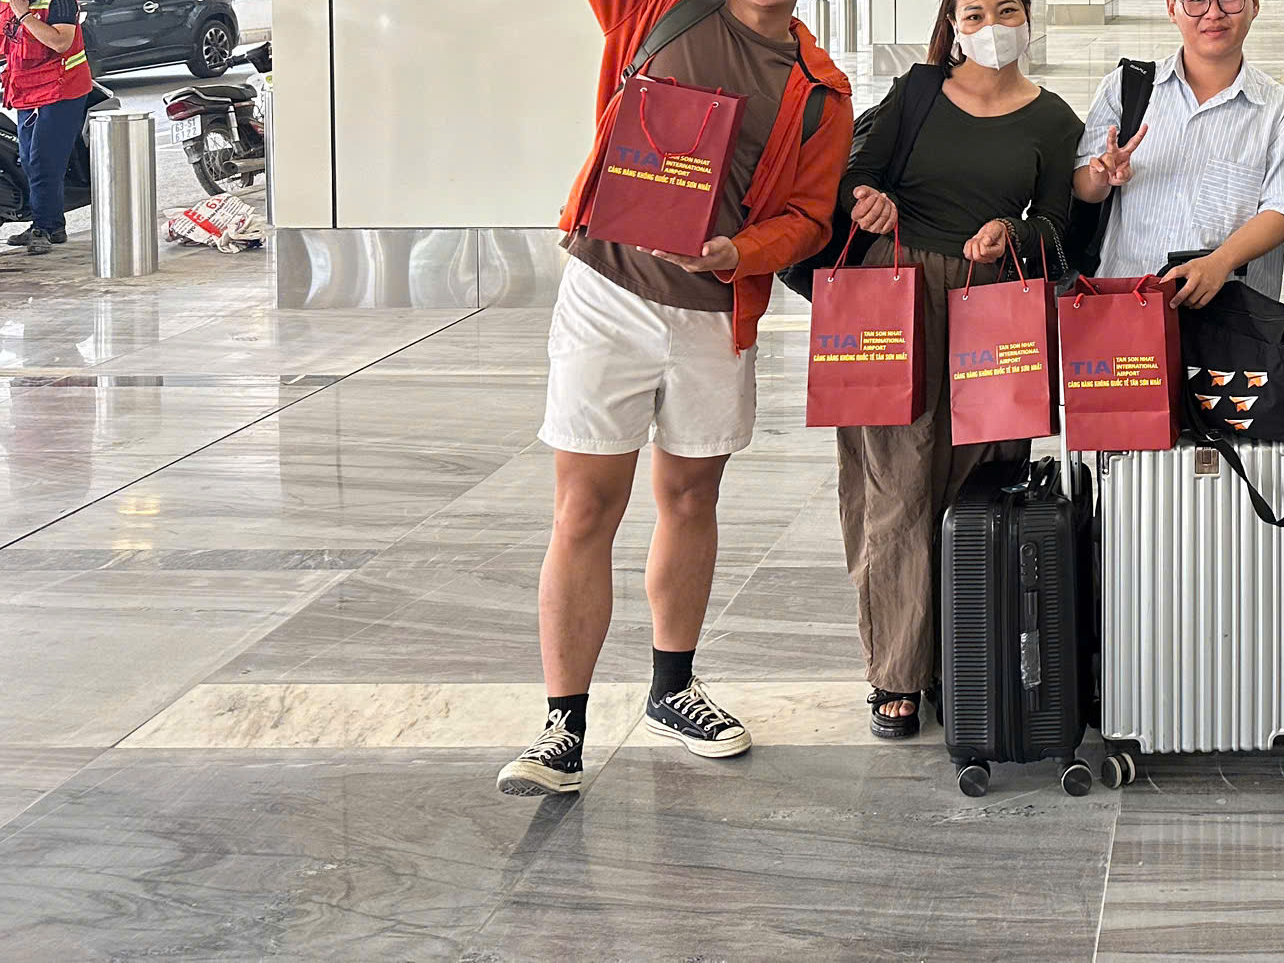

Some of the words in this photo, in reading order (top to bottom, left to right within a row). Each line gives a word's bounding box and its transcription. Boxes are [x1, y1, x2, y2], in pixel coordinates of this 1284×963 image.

[616, 146, 659, 167] TIA
[694, 158, 710, 166] NHAT
[664, 168, 691, 177] AIRPORT
[666, 160, 712, 174] INTERNATIONAL
[637, 170, 655, 181] KHÔNG
[817, 334, 858, 349] TIA
[953, 350, 994, 366] TIA
[998, 348, 1040, 357] INTERNATIONAL
[1069, 360, 1112, 374] TIA
